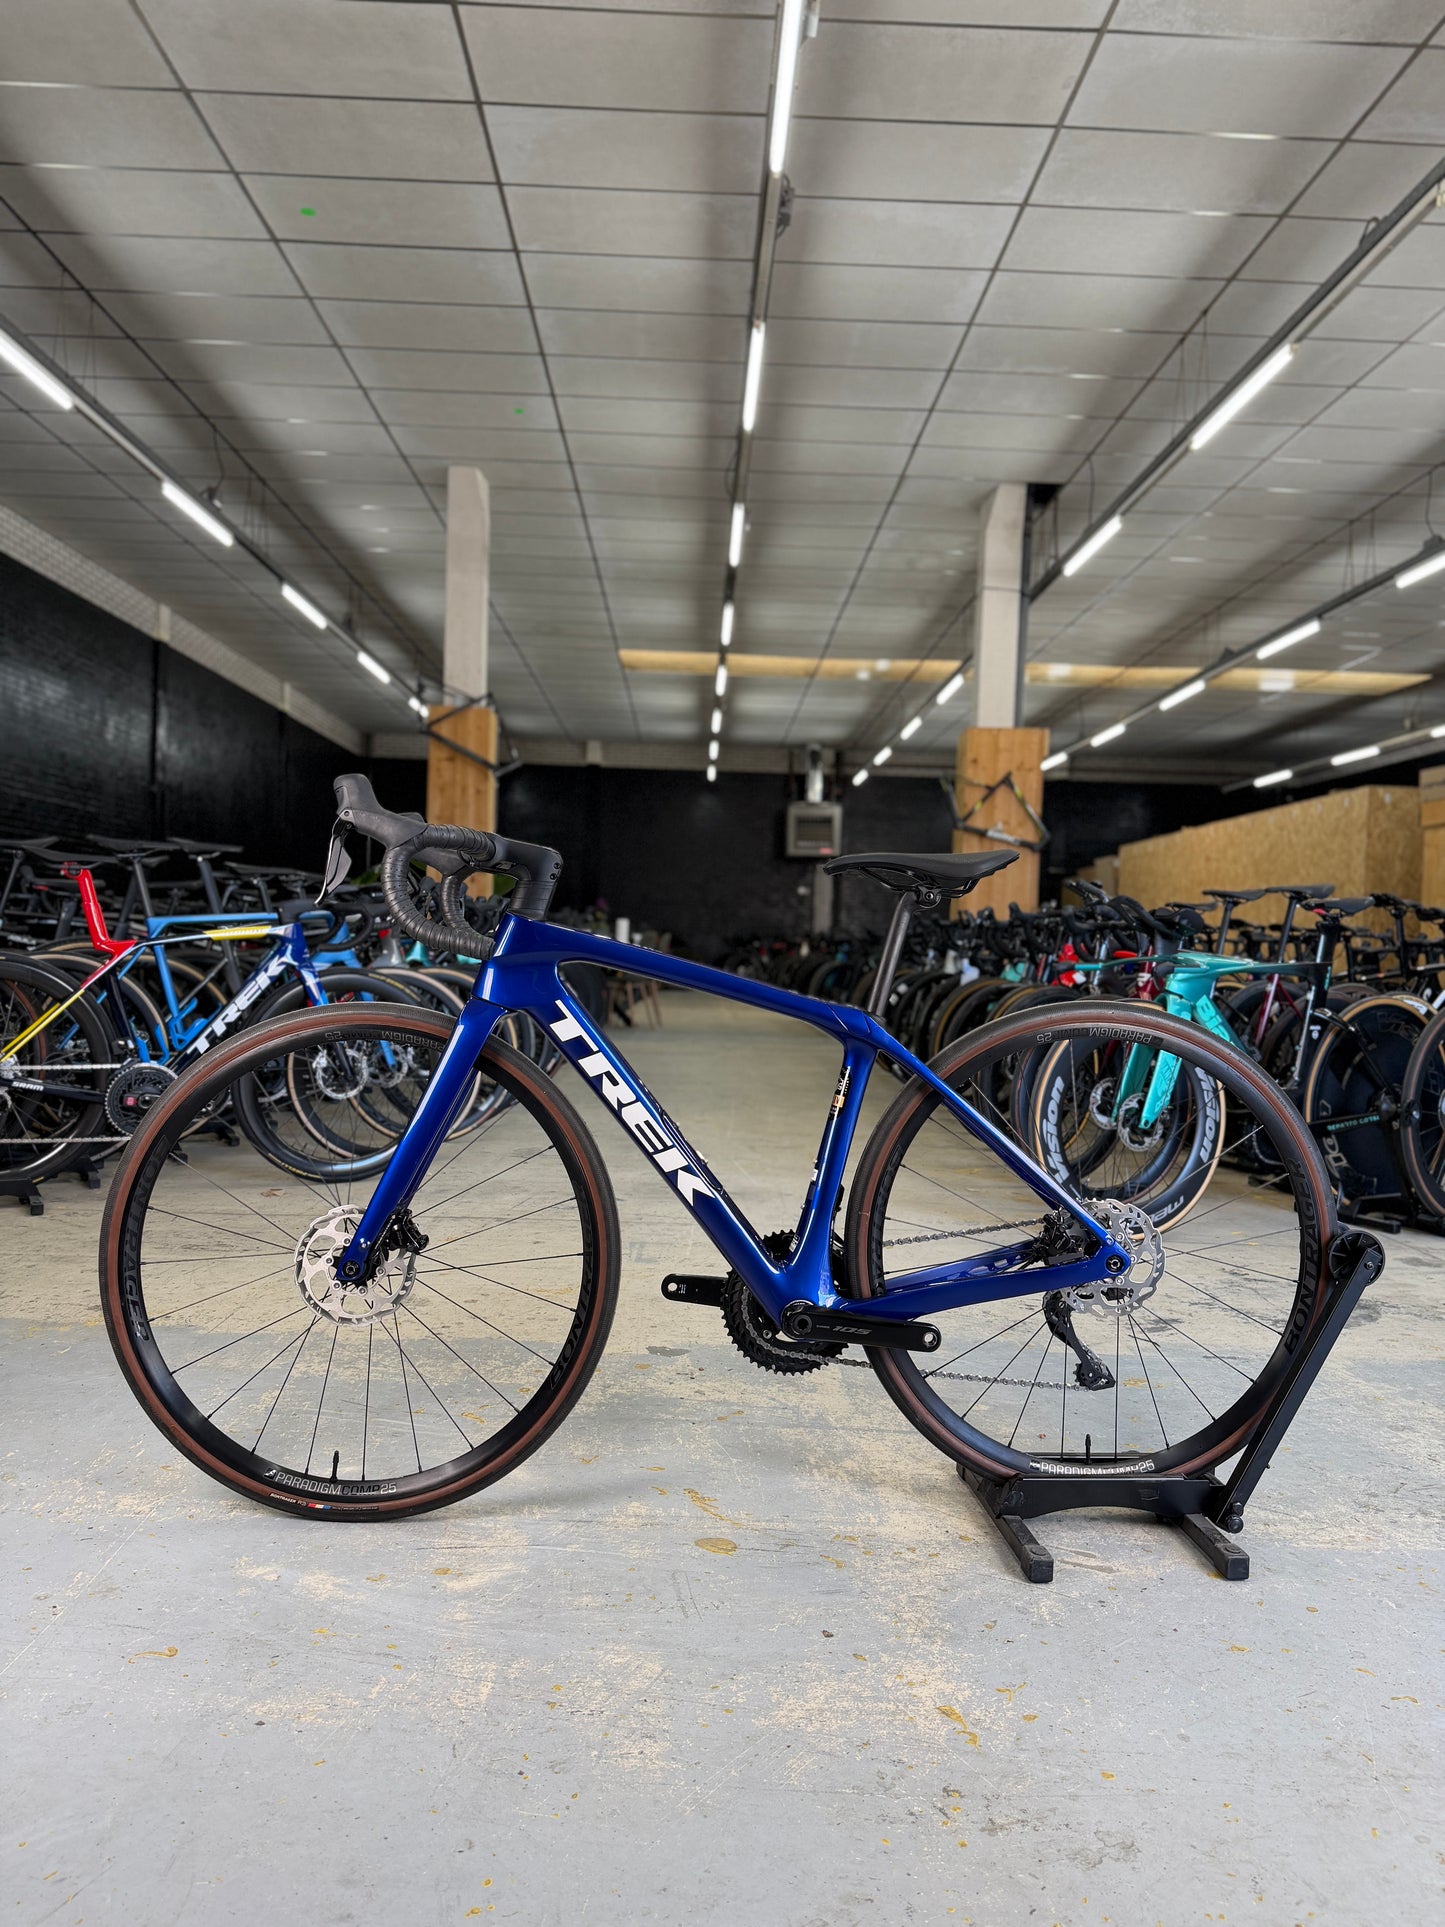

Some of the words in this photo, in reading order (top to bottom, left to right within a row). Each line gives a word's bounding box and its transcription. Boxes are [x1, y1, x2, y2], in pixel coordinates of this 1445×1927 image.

[187, 954, 287, 1054] TREK
[324, 1031, 342, 1041] 25
[1036, 1031, 1053, 1043] 25
[1089, 1027, 1153, 1044] PARADIGM
[11, 1080, 44, 1092] SRAM
[549, 999, 716, 1207] TREK
[1284, 1156, 1319, 1355] BONTRAGER
[832, 1325, 872, 1335] 105
[1138, 1459, 1156, 1473] 25
[276, 1471, 342, 1495] PARADIGM
[341, 1484, 380, 1496] COMP
[380, 1482, 397, 1495] 25
